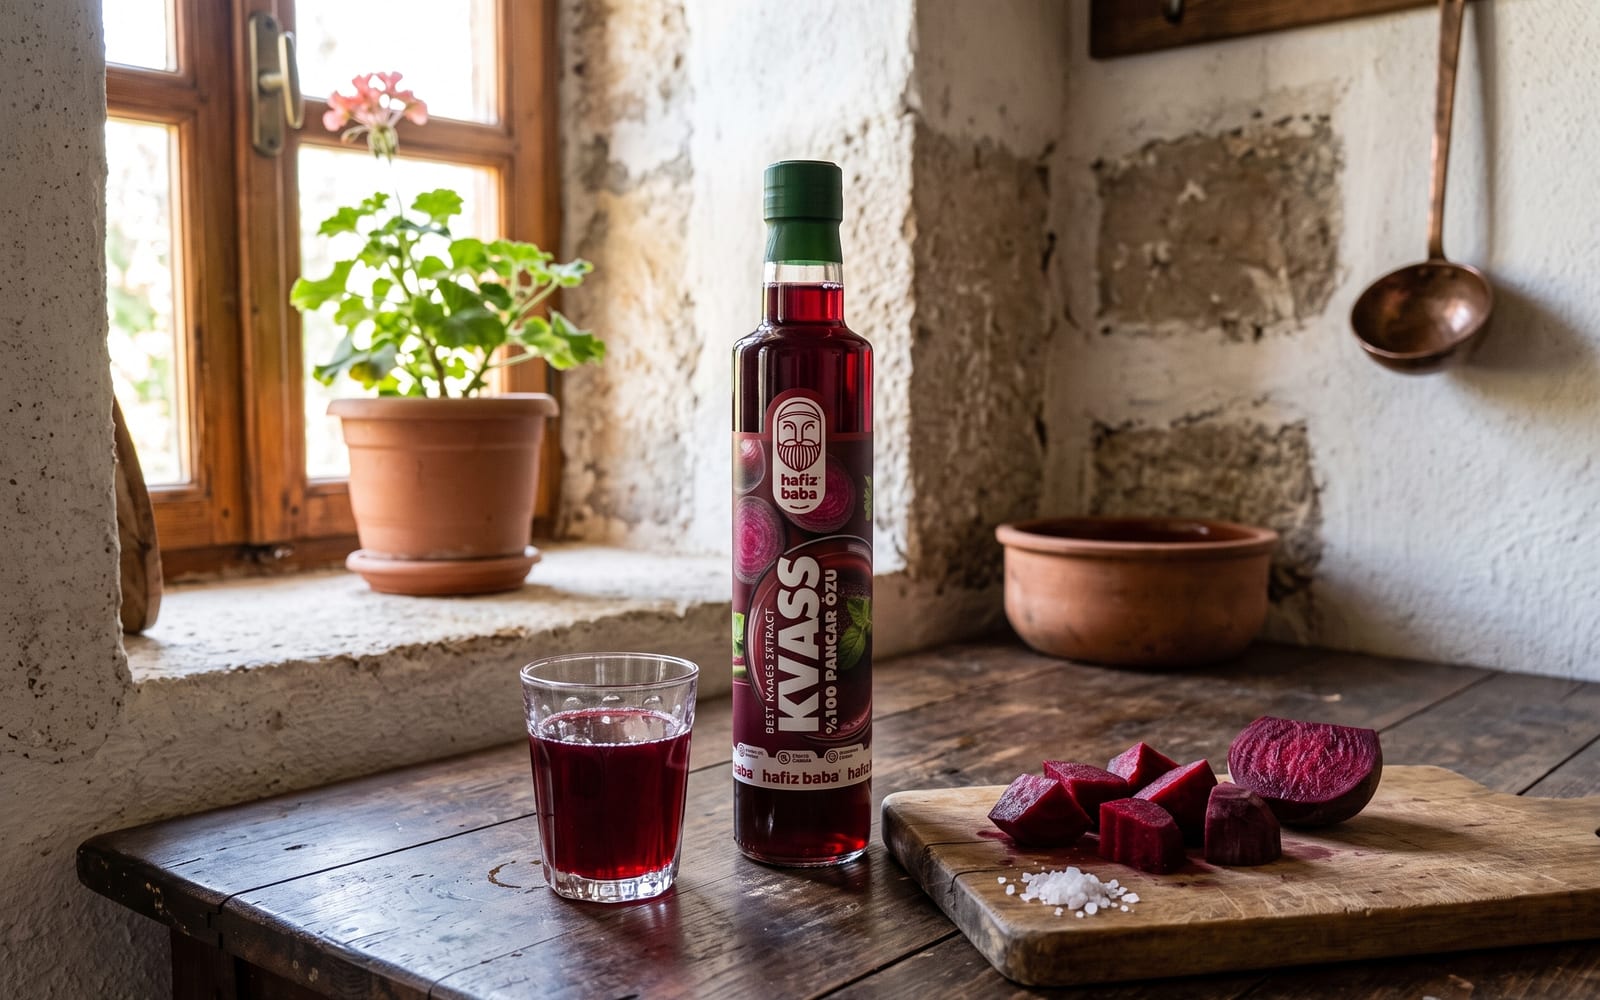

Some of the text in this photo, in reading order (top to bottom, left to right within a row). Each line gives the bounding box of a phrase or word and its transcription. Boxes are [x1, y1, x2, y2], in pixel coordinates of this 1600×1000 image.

[781, 473, 818, 486] hafiz
[781, 487, 818, 500] baba
[777, 556, 820, 732] KVASS
[825, 610, 838, 682] PANCAR
[825, 685, 838, 734] %100
[762, 769, 800, 785] hafiz
[802, 771, 839, 785] baba
[847, 763, 869, 781] hafiz
